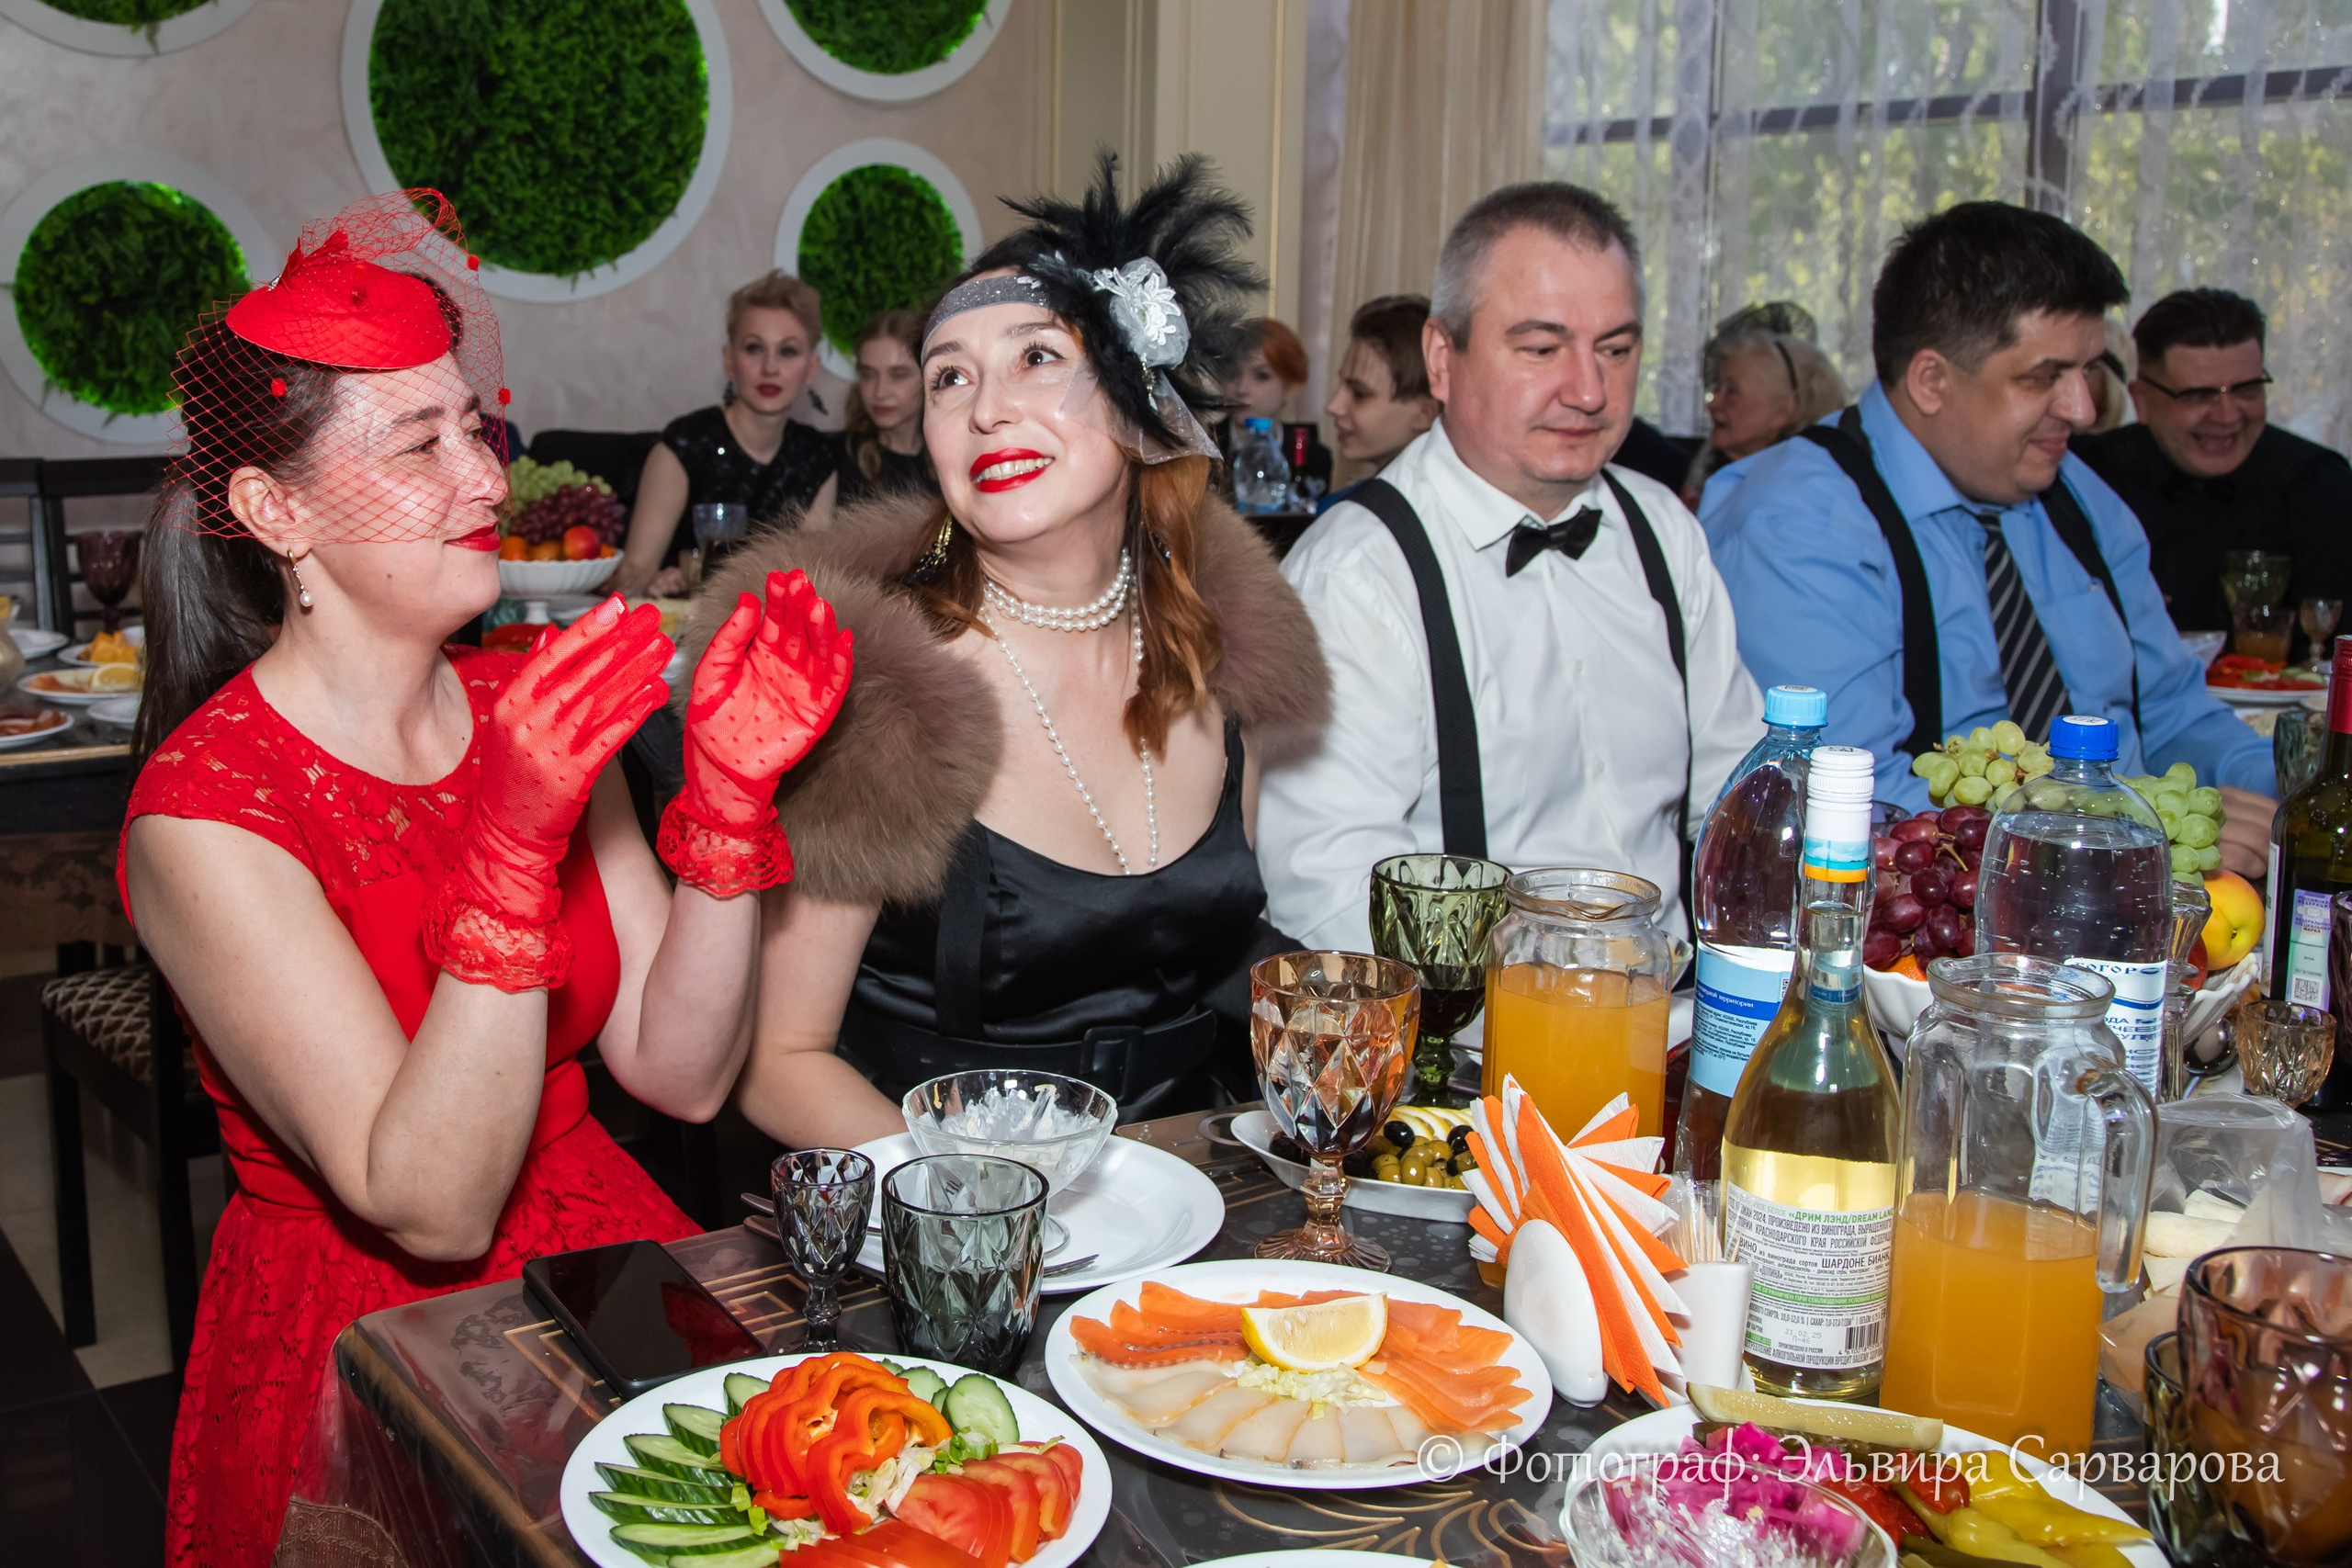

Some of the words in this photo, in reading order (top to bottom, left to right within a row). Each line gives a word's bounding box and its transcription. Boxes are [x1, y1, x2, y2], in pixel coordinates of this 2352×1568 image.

[1719, 995, 1754, 1009] территории
[1768, 1214, 1811, 1234] ПРОИЗВЕДЕНО
[1811, 1224, 1820, 1235] ИЗ
[1821, 1224, 1856, 1236] ВИНОГРАДА,
[1789, 1211, 1822, 1223] «ДРИМ
[1824, 1212, 1878, 1224] ЛЭНД/DREAM
[1755, 1224, 1807, 1247] КРАСНОДАРСКОГО
[1810, 1236, 1826, 1248] КРАЯ
[1830, 1235, 1868, 1249] РОССИЙСКОЙ
[1739, 1236, 1758, 1253] ВИНО
[1768, 1253, 1796, 1264] винограда
[1762, 1287, 1794, 1300] ОГРАНИЧЕН
[1808, 1296, 1848, 1304] СОБЛЮДЕНИИ
[1772, 1348, 1806, 1363] АЛКОГОЛЬНОЙ
[1806, 1354, 1835, 1366] ПРОДУКЦИИ
[1835, 1355, 1852, 1366] ВРЕДИТ
